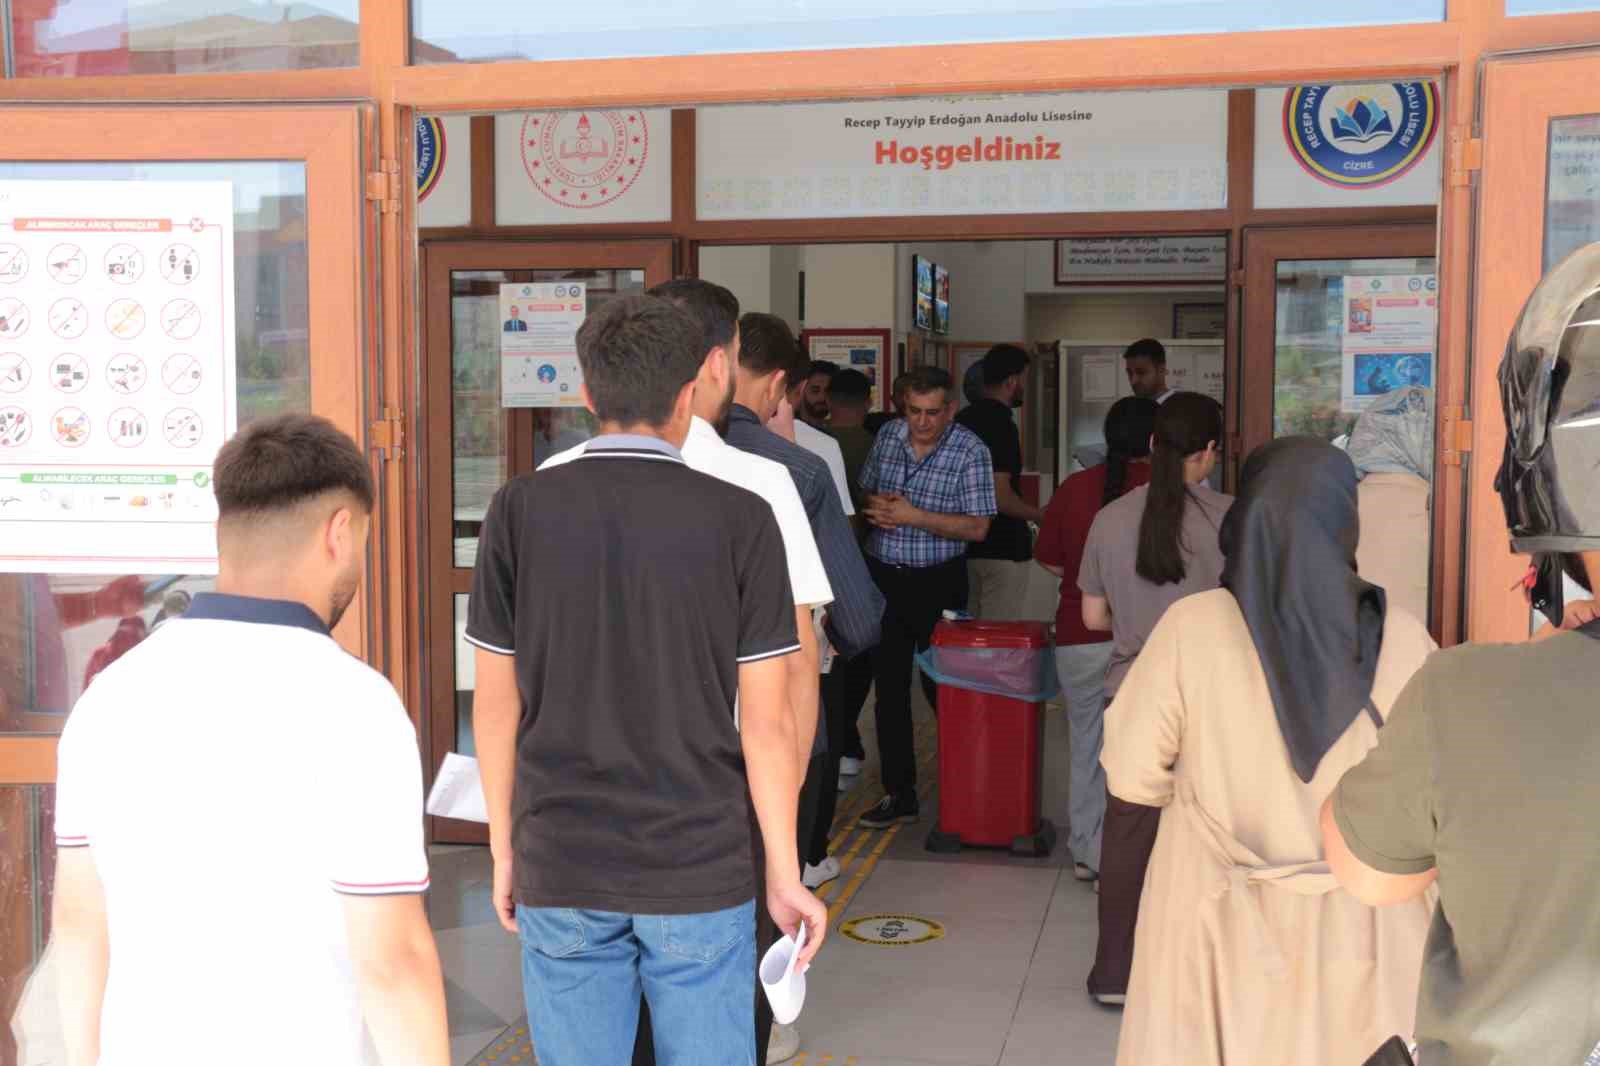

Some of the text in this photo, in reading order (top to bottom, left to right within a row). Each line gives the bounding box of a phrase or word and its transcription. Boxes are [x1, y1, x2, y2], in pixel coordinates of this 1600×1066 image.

[844, 109, 1093, 129] Recep Tayyip Erdoğan Anadolu Lisesine
[1303, 113, 1321, 148] RECEP
[875, 136, 1062, 171] Hoşgeldiniz
[1343, 160, 1375, 170] CİZRE
